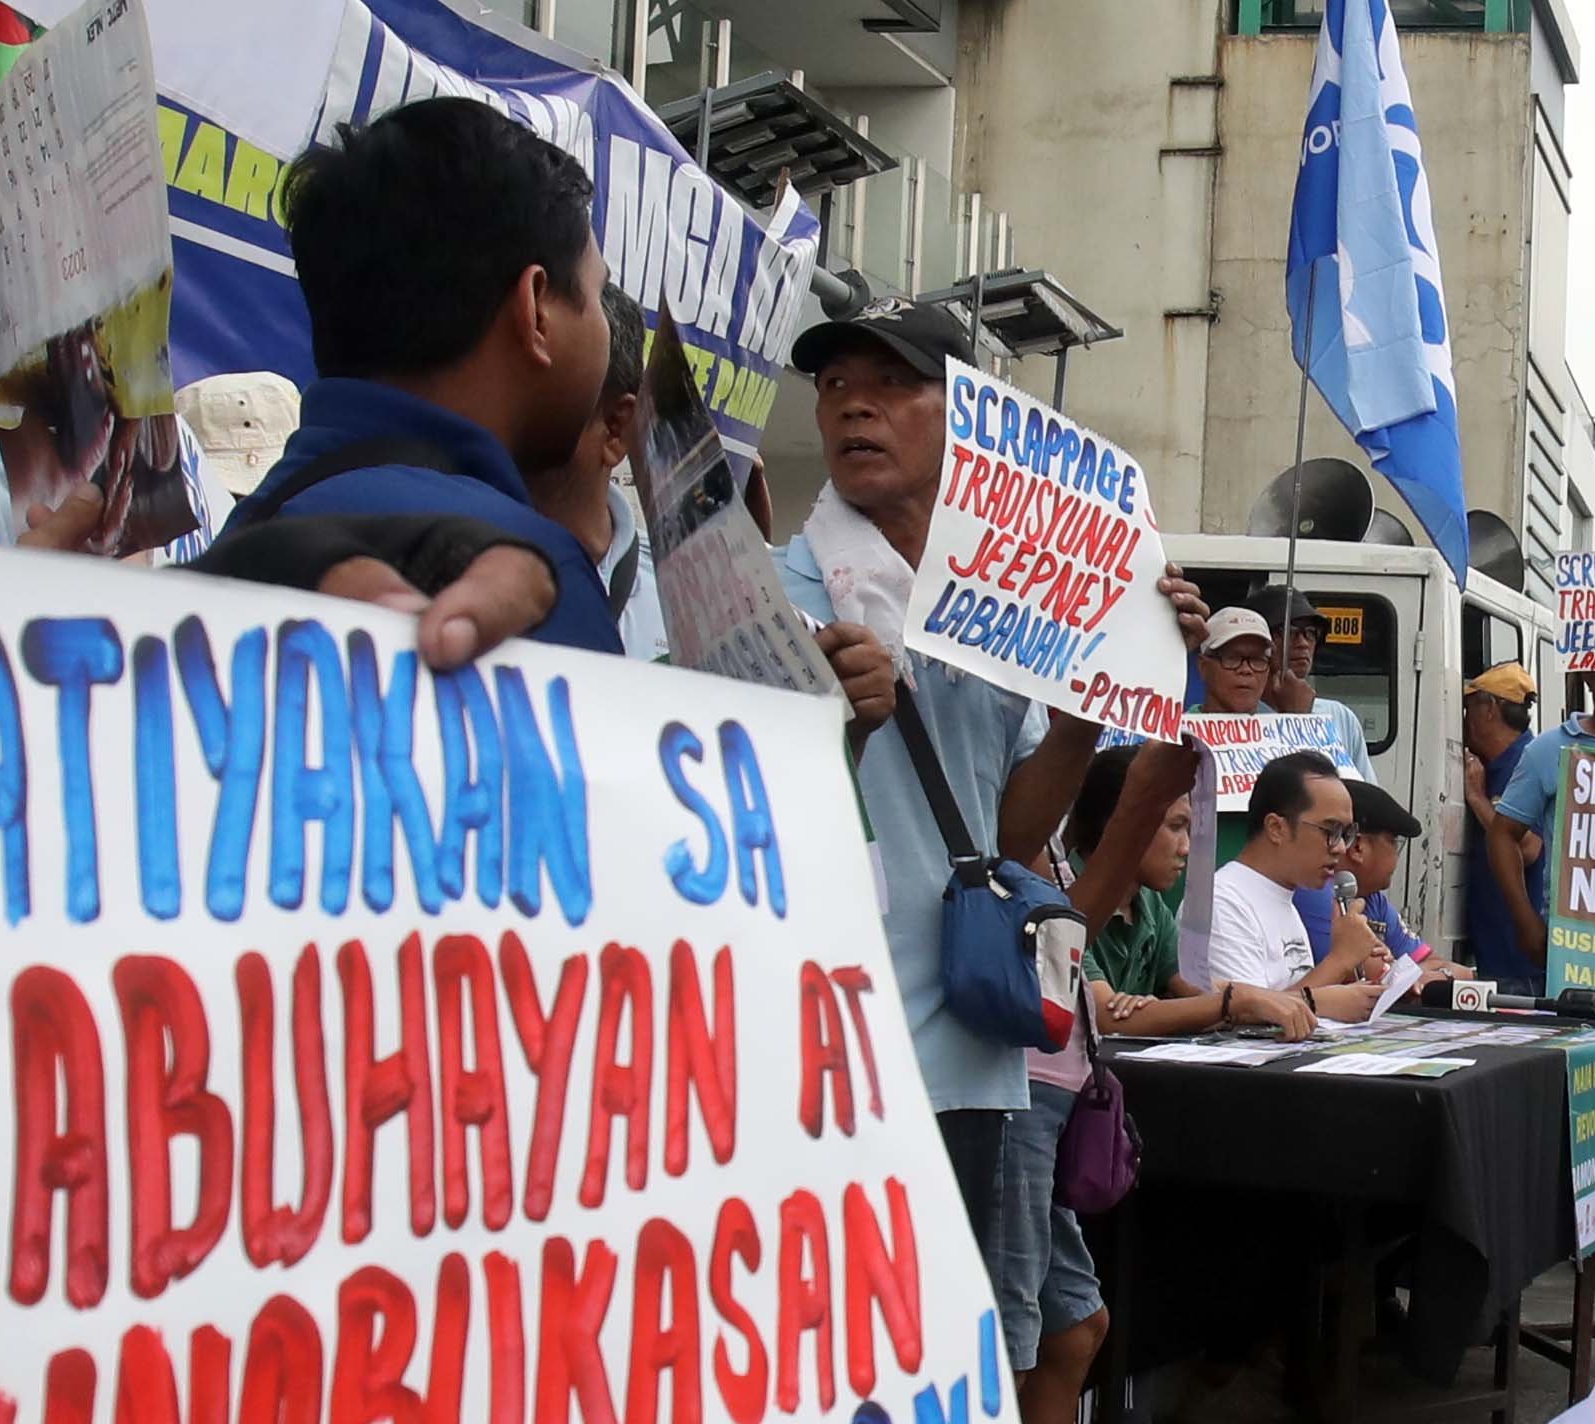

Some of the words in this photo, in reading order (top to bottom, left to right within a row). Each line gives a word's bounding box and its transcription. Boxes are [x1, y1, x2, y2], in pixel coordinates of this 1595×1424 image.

[602, 134, 745, 341] MGA
[943, 443, 1143, 584] TRADISYUNAL
[949, 374, 1138, 515] SCRAPPAGE
[948, 527, 1127, 633] JEEPNEY
[659, 717, 788, 919] SA
[797, 960, 884, 1140] AT
